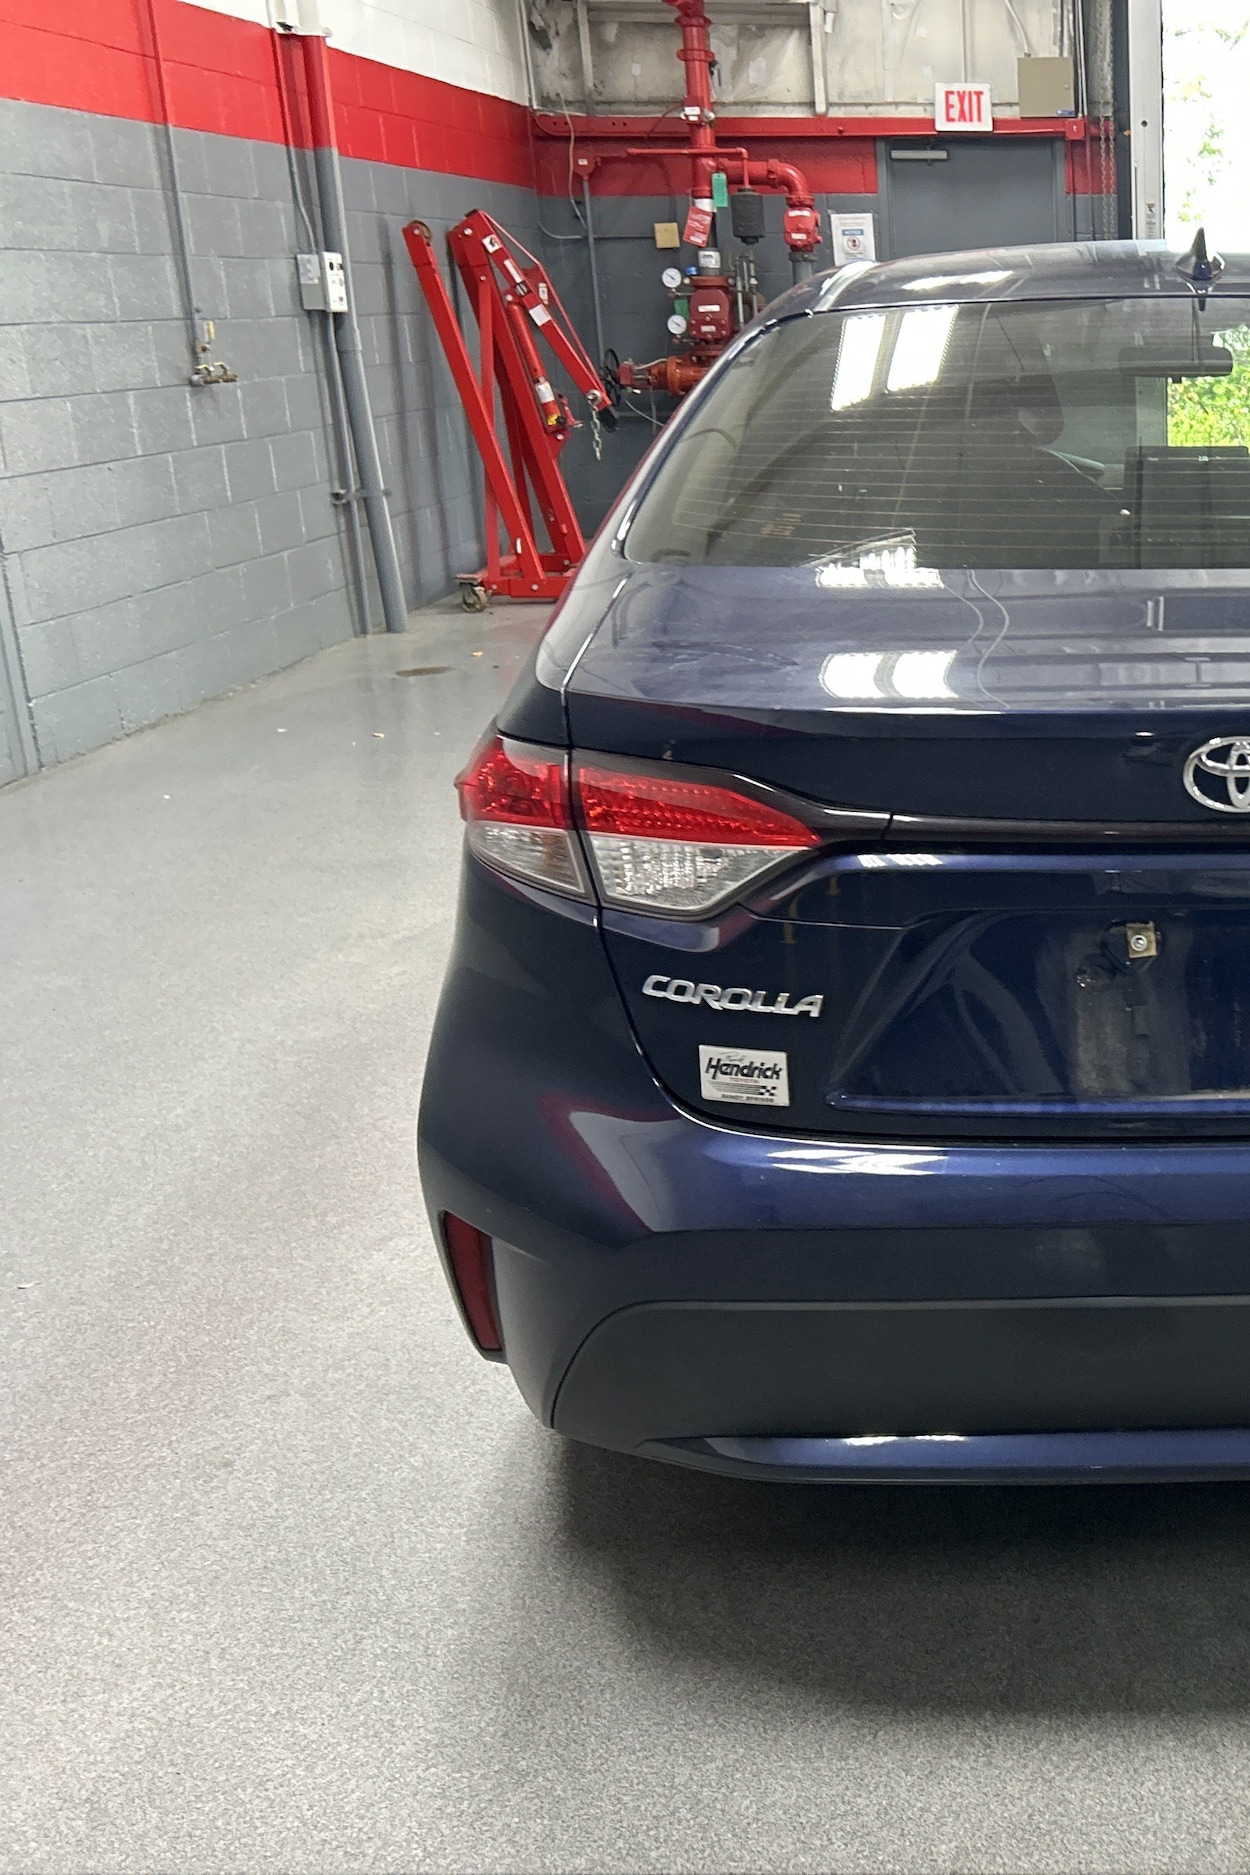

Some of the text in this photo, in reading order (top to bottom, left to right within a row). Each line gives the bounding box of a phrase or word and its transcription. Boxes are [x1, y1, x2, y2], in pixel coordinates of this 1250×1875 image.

[944, 90, 984, 122] EXIT
[641, 974, 824, 1018] COROLLA
[705, 1057, 783, 1080] Hendrick
